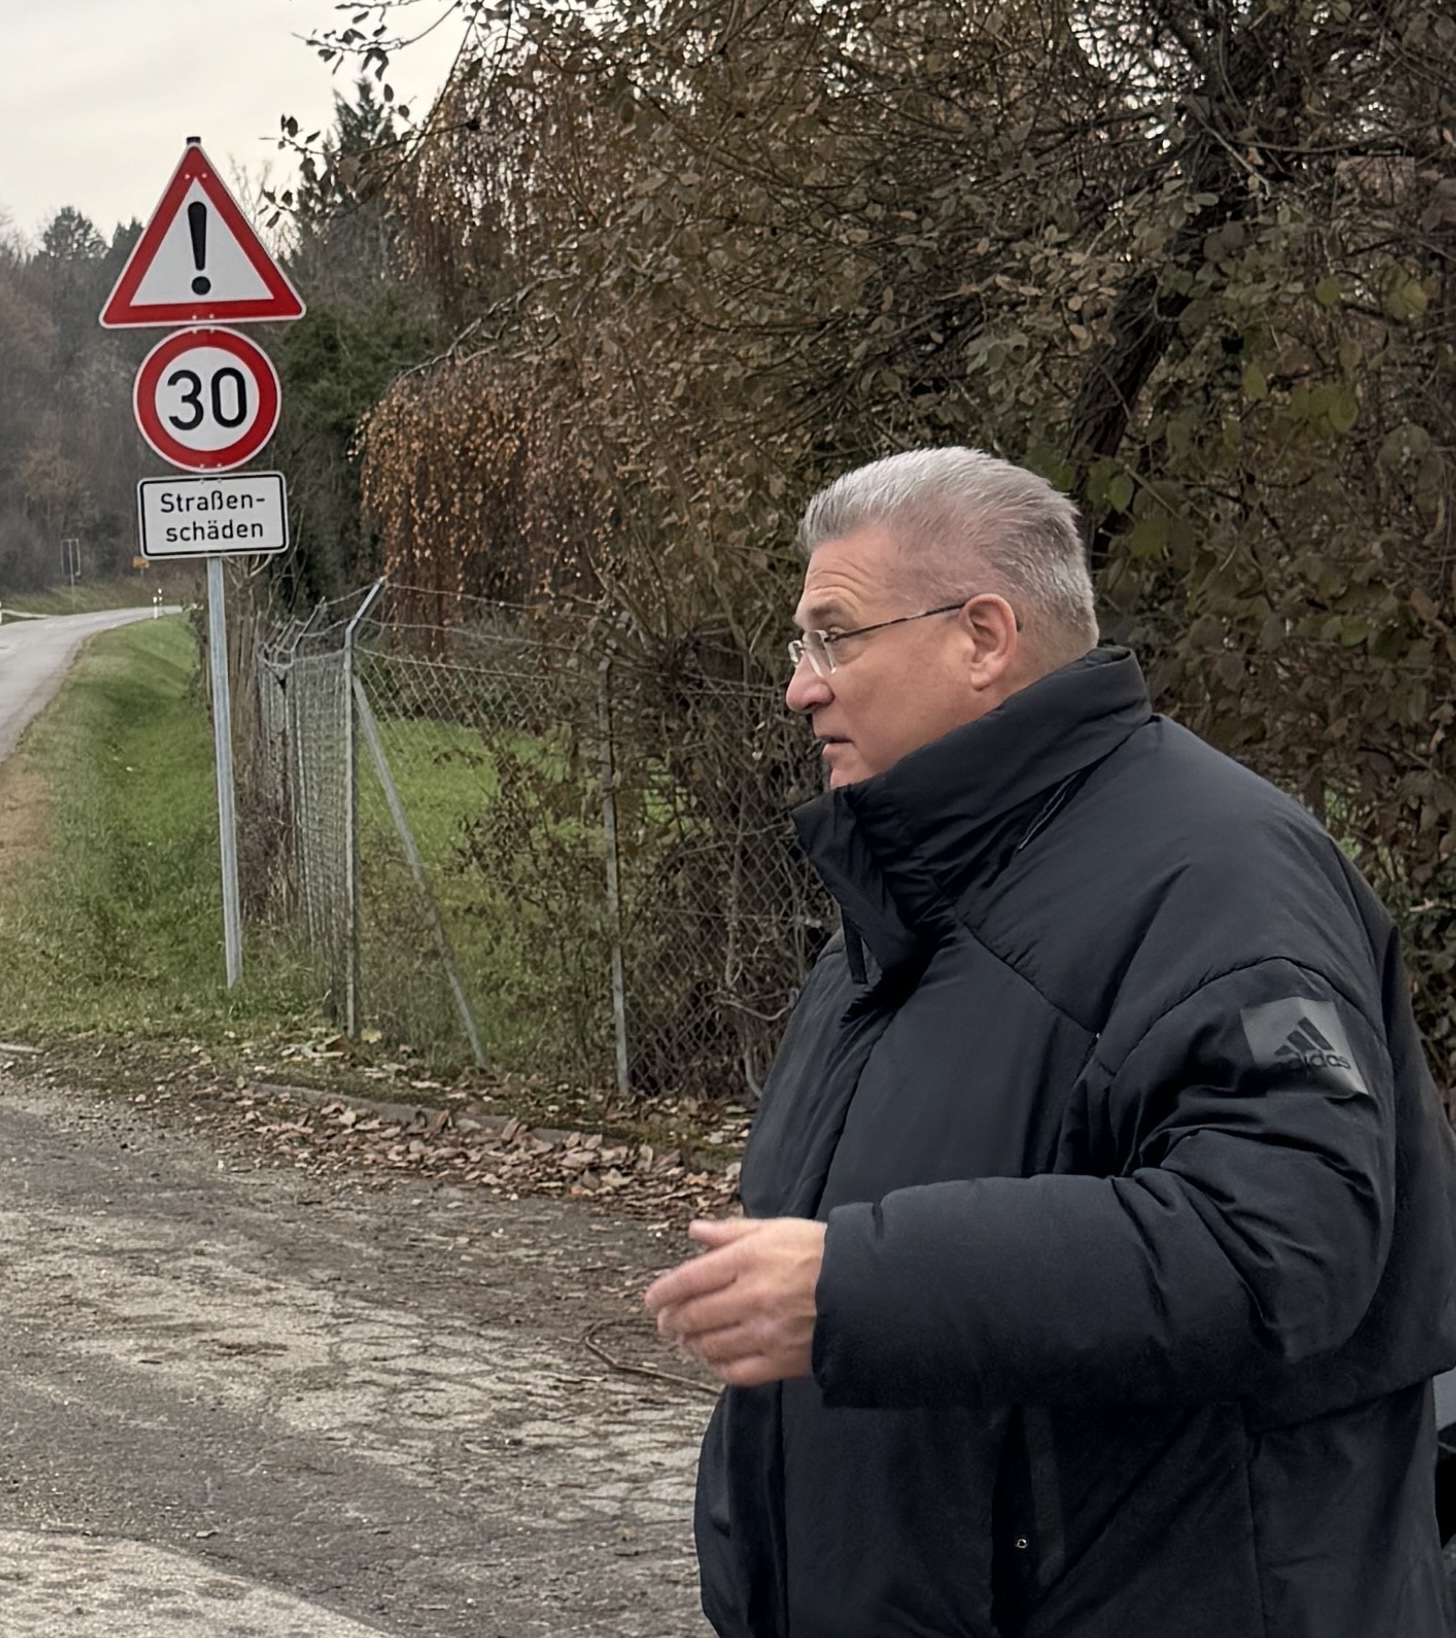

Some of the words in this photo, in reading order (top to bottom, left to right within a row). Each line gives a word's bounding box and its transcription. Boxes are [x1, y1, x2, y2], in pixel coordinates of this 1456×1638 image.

[167, 367, 247, 430] 30
[160, 490, 266, 513] Straßen-
[165, 519, 264, 543] schäden
